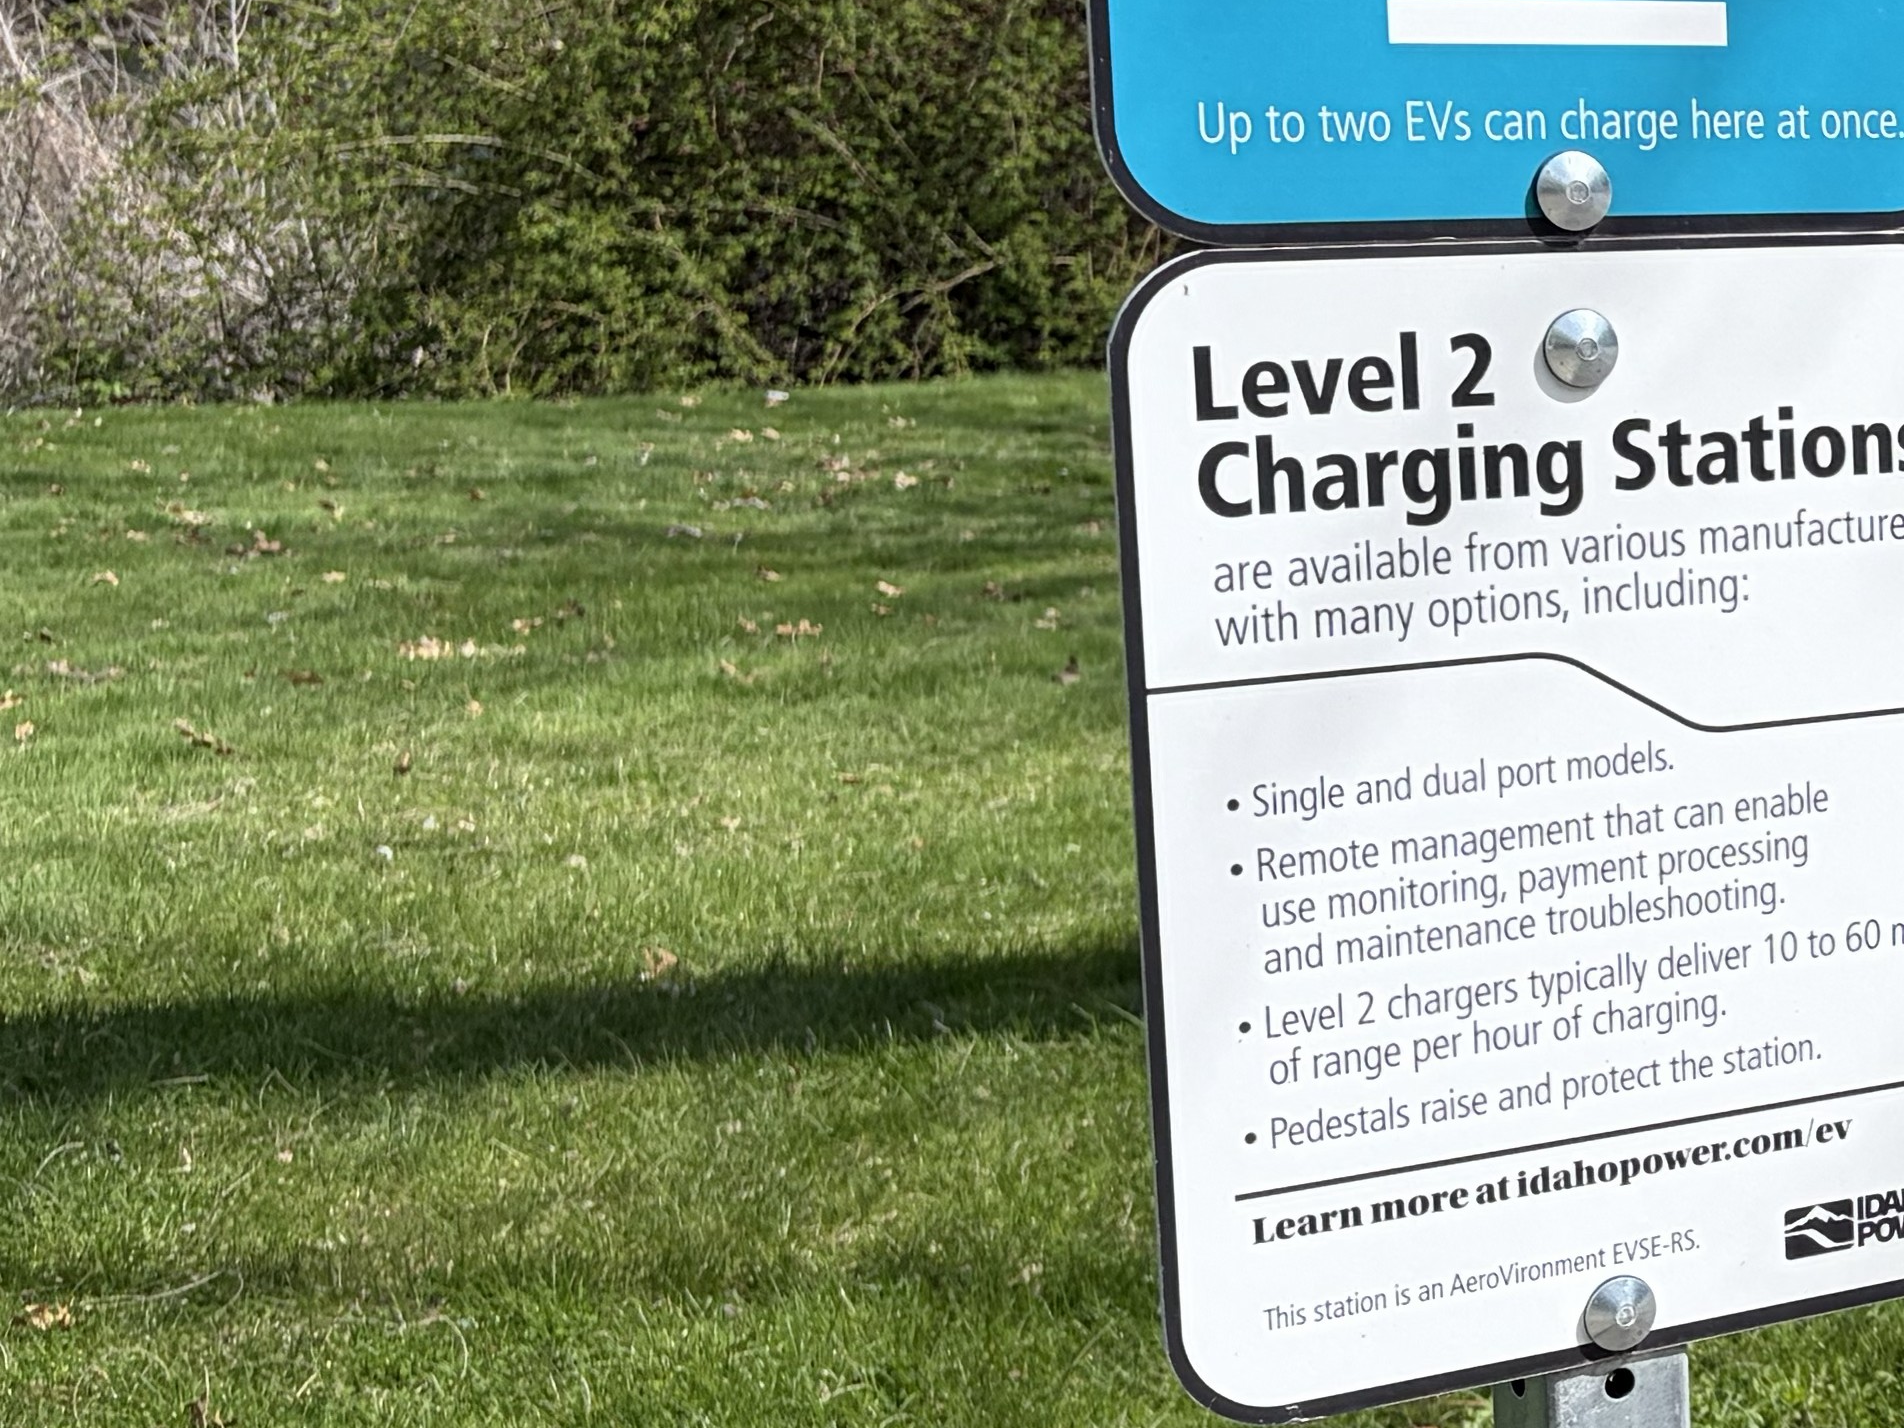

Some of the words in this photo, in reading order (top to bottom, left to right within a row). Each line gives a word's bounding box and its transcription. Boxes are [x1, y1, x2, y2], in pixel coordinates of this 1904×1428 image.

[1198, 102, 1251, 154] Up
[1266, 106, 1304, 142] to
[1318, 106, 1390, 142] two
[1406, 101, 1471, 141] EVs
[1485, 110, 1546, 140] can
[1561, 98, 1677, 150] charge
[1692, 98, 1764, 139] here
[1778, 105, 1810, 139] at
[1821, 110, 1904, 138] once.
[1193, 332, 1419, 421] Level
[1451, 333, 1494, 407] 2
[1198, 423, 1583, 526] Charging
[1214, 560, 1272, 593] are
[1289, 536, 1451, 586] available
[1465, 531, 1547, 572] from
[1562, 524, 1685, 564] various
[1215, 600, 1298, 646] with
[1315, 602, 1413, 642] many
[1429, 585, 1568, 637] options,
[1583, 568, 1748, 614] including:
[1253, 776, 1344, 821] Single
[1357, 766, 1411, 805] and
[1423, 758, 1485, 797] dual
[1498, 756, 1556, 798] port
[1567, 740, 1673, 781] models.
[1257, 841, 1378, 881] Remote
[1392, 813, 1594, 875] management
[1604, 803, 1664, 838] that
[1674, 802, 1723, 829] can
[1735, 781, 1828, 822] enable
[1263, 898, 1315, 927] use
[1328, 870, 1506, 919] monitoring,
[1519, 851, 1648, 904] payment
[1659, 831, 1808, 885] processing
[1265, 932, 1323, 974] and
[1337, 915, 1535, 964] maintenance
[1546, 877, 1786, 935] troubleshooting.
[1266, 993, 1343, 1038] Level
[1358, 991, 1375, 1025] 2
[1388, 978, 1518, 1020] chargers
[1528, 952, 1647, 1007] typically
[1658, 942, 1751, 980] deliver
[1765, 931, 1797, 964] 10
[1808, 931, 1835, 958] to
[1846, 919, 1880, 952] 60
[1270, 1046, 1301, 1085] of
[1313, 1043, 1401, 1080] range
[1413, 1033, 1462, 1073] per
[1474, 1020, 1542, 1054] hour
[1553, 1004, 1582, 1041] of
[1593, 991, 1726, 1035] charging.
[1271, 1097, 1410, 1149] Pedestals
[1421, 1088, 1487, 1124] raise
[1499, 1072, 1551, 1111] and
[1563, 1060, 1661, 1109] protect
[1670, 1050, 1713, 1083] the
[1724, 1036, 1821, 1074] station.
[1253, 1207, 1362, 1244] Learn
[1372, 1189, 1468, 1223] more
[1476, 1177, 1509, 1204] at
[1516, 1115, 1854, 1199] idahopower.com/ev
[1263, 1304, 1306, 1330] This
[1314, 1293, 1387, 1322] station
[1395, 1288, 1411, 1306] is
[1419, 1283, 1443, 1302] an
[1450, 1249, 1605, 1296] AeroVironment
[1613, 1228, 1701, 1265] EVSE-RS.
